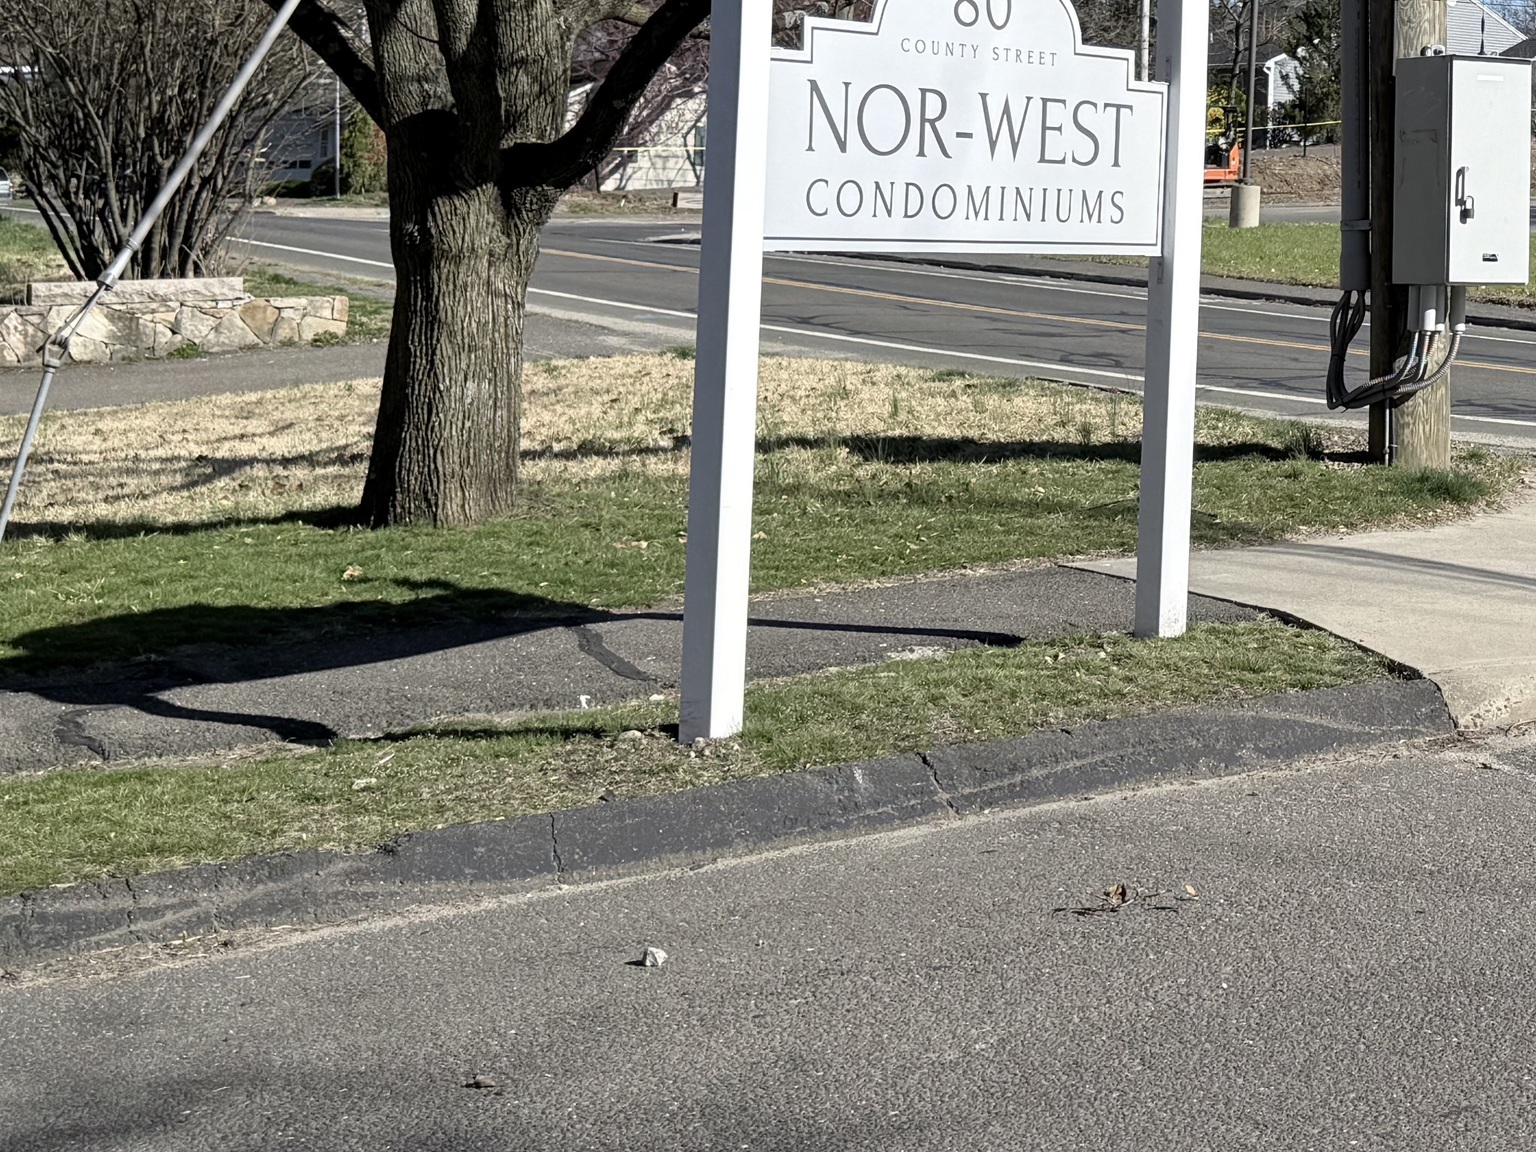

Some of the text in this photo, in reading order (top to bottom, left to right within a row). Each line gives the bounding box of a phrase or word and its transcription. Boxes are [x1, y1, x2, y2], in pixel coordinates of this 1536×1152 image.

[900, 37, 1058, 67] COUNTY STREET
[805, 78, 1134, 168] NOR-WEST
[805, 177, 1126, 225] CONDOMINIUMS
